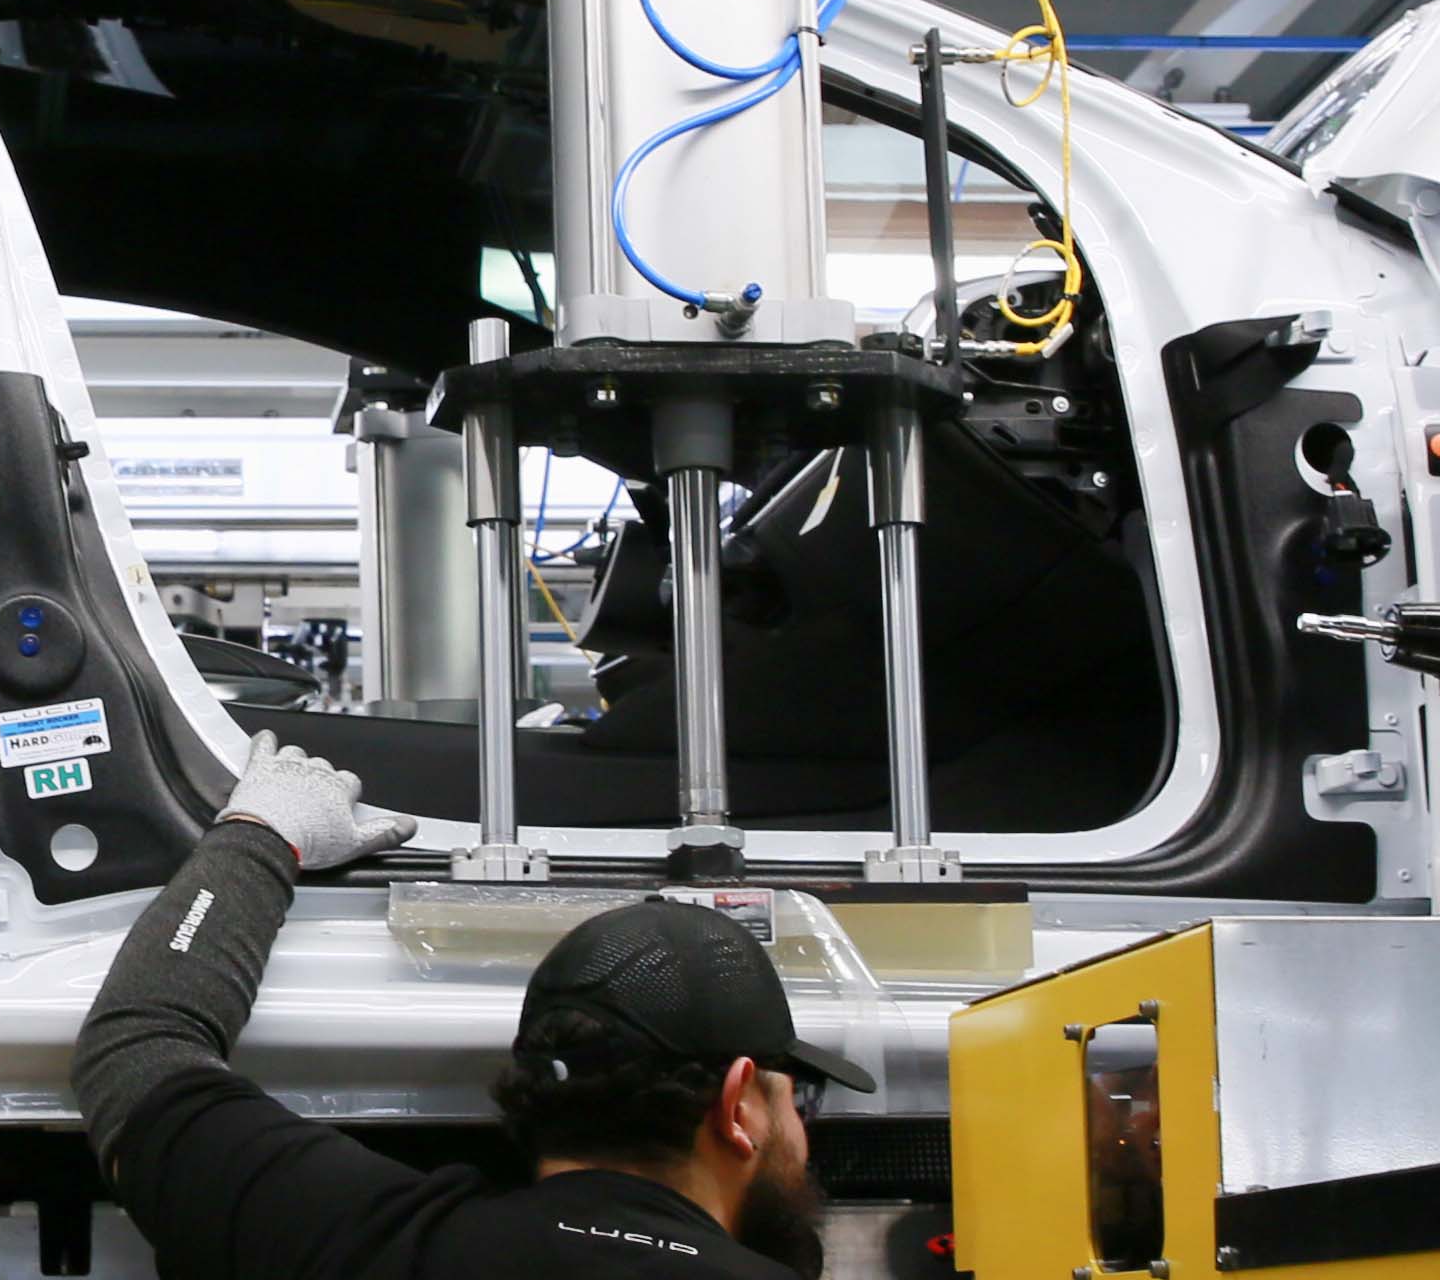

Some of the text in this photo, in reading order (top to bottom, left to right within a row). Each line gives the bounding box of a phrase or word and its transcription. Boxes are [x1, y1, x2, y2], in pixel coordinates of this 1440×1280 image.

[1, 702, 94, 722] LUCID
[31, 762, 85, 794] RH
[558, 1222, 699, 1256] LUCID
